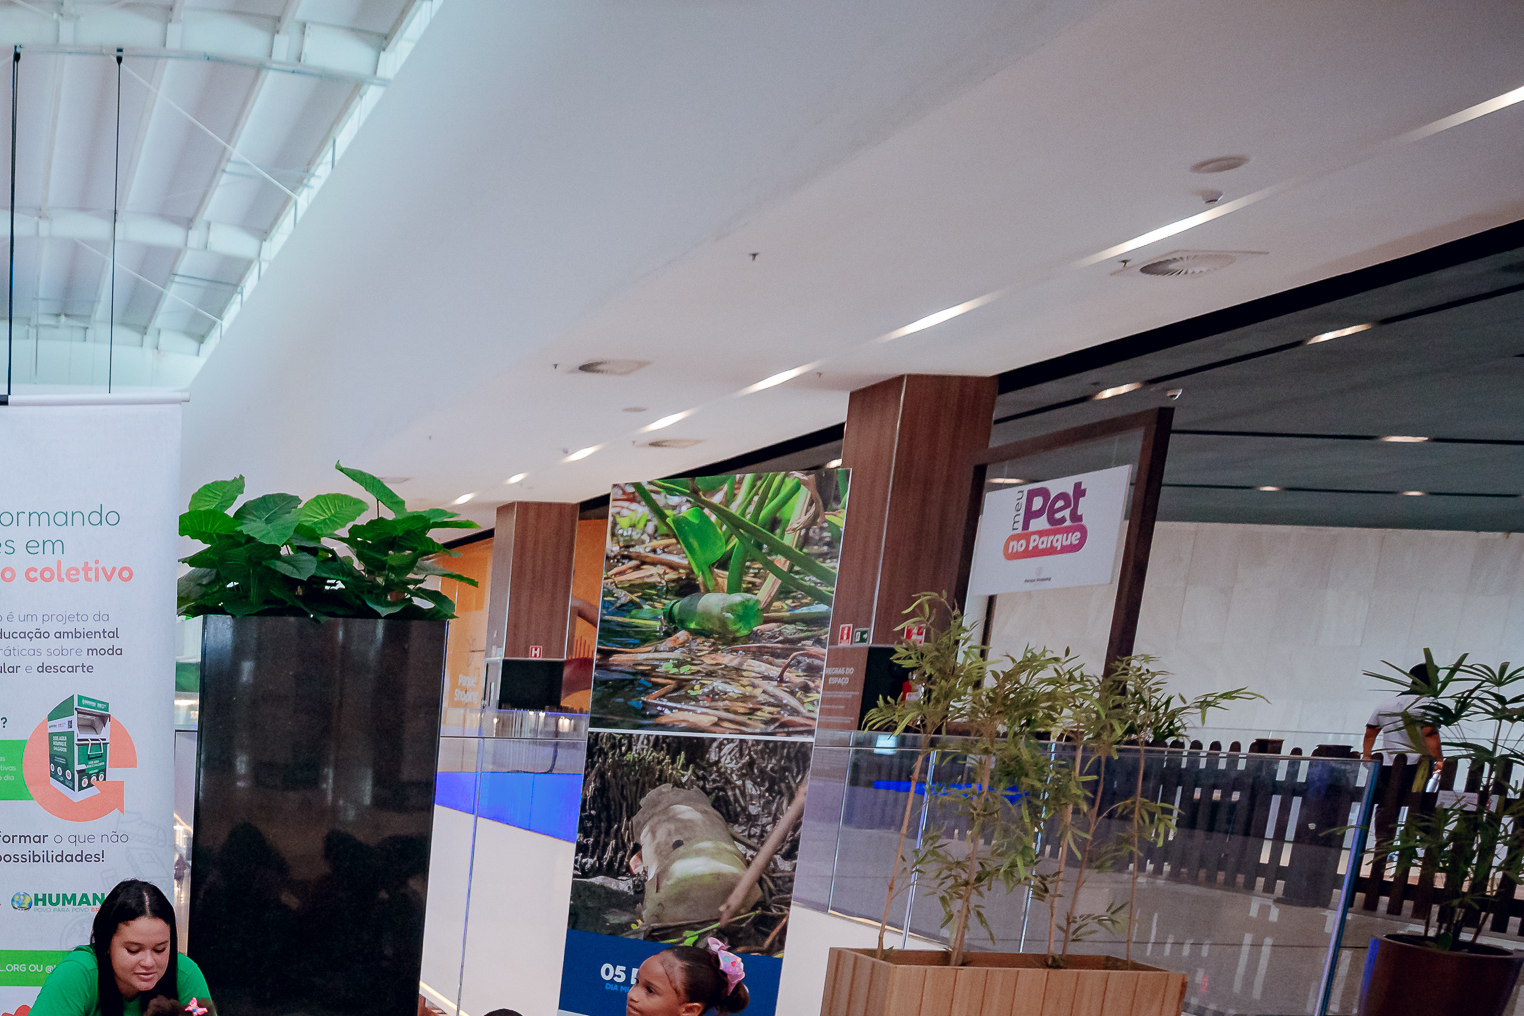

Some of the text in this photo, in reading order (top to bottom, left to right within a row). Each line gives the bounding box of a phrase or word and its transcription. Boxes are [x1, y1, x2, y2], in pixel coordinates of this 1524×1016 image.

[1012, 490, 1024, 531] meu
[1022, 481, 1087, 531] Pet
[25, 539, 65, 555] em
[1008, 531, 1081, 554] no Parque
[24, 560, 134, 583] coletivo
[6, 611, 14, 622] é
[18, 612, 38, 622] um
[42, 611, 89, 625] projeto
[93, 610, 110, 622] da
[54, 628, 120, 640] ambiental
[46, 645, 83, 657] sobre
[86, 645, 123, 656] moda
[24, 665, 33, 674] e
[36, 662, 94, 674] descarte
[54, 834, 63, 844] o
[68, 834, 96, 846] que
[100, 831, 129, 844] não
[34, 892, 106, 906] HUMAN
[28, 964, 43, 972] OU
[600, 963, 626, 982] 05
[605, 982, 619, 992] DIA
